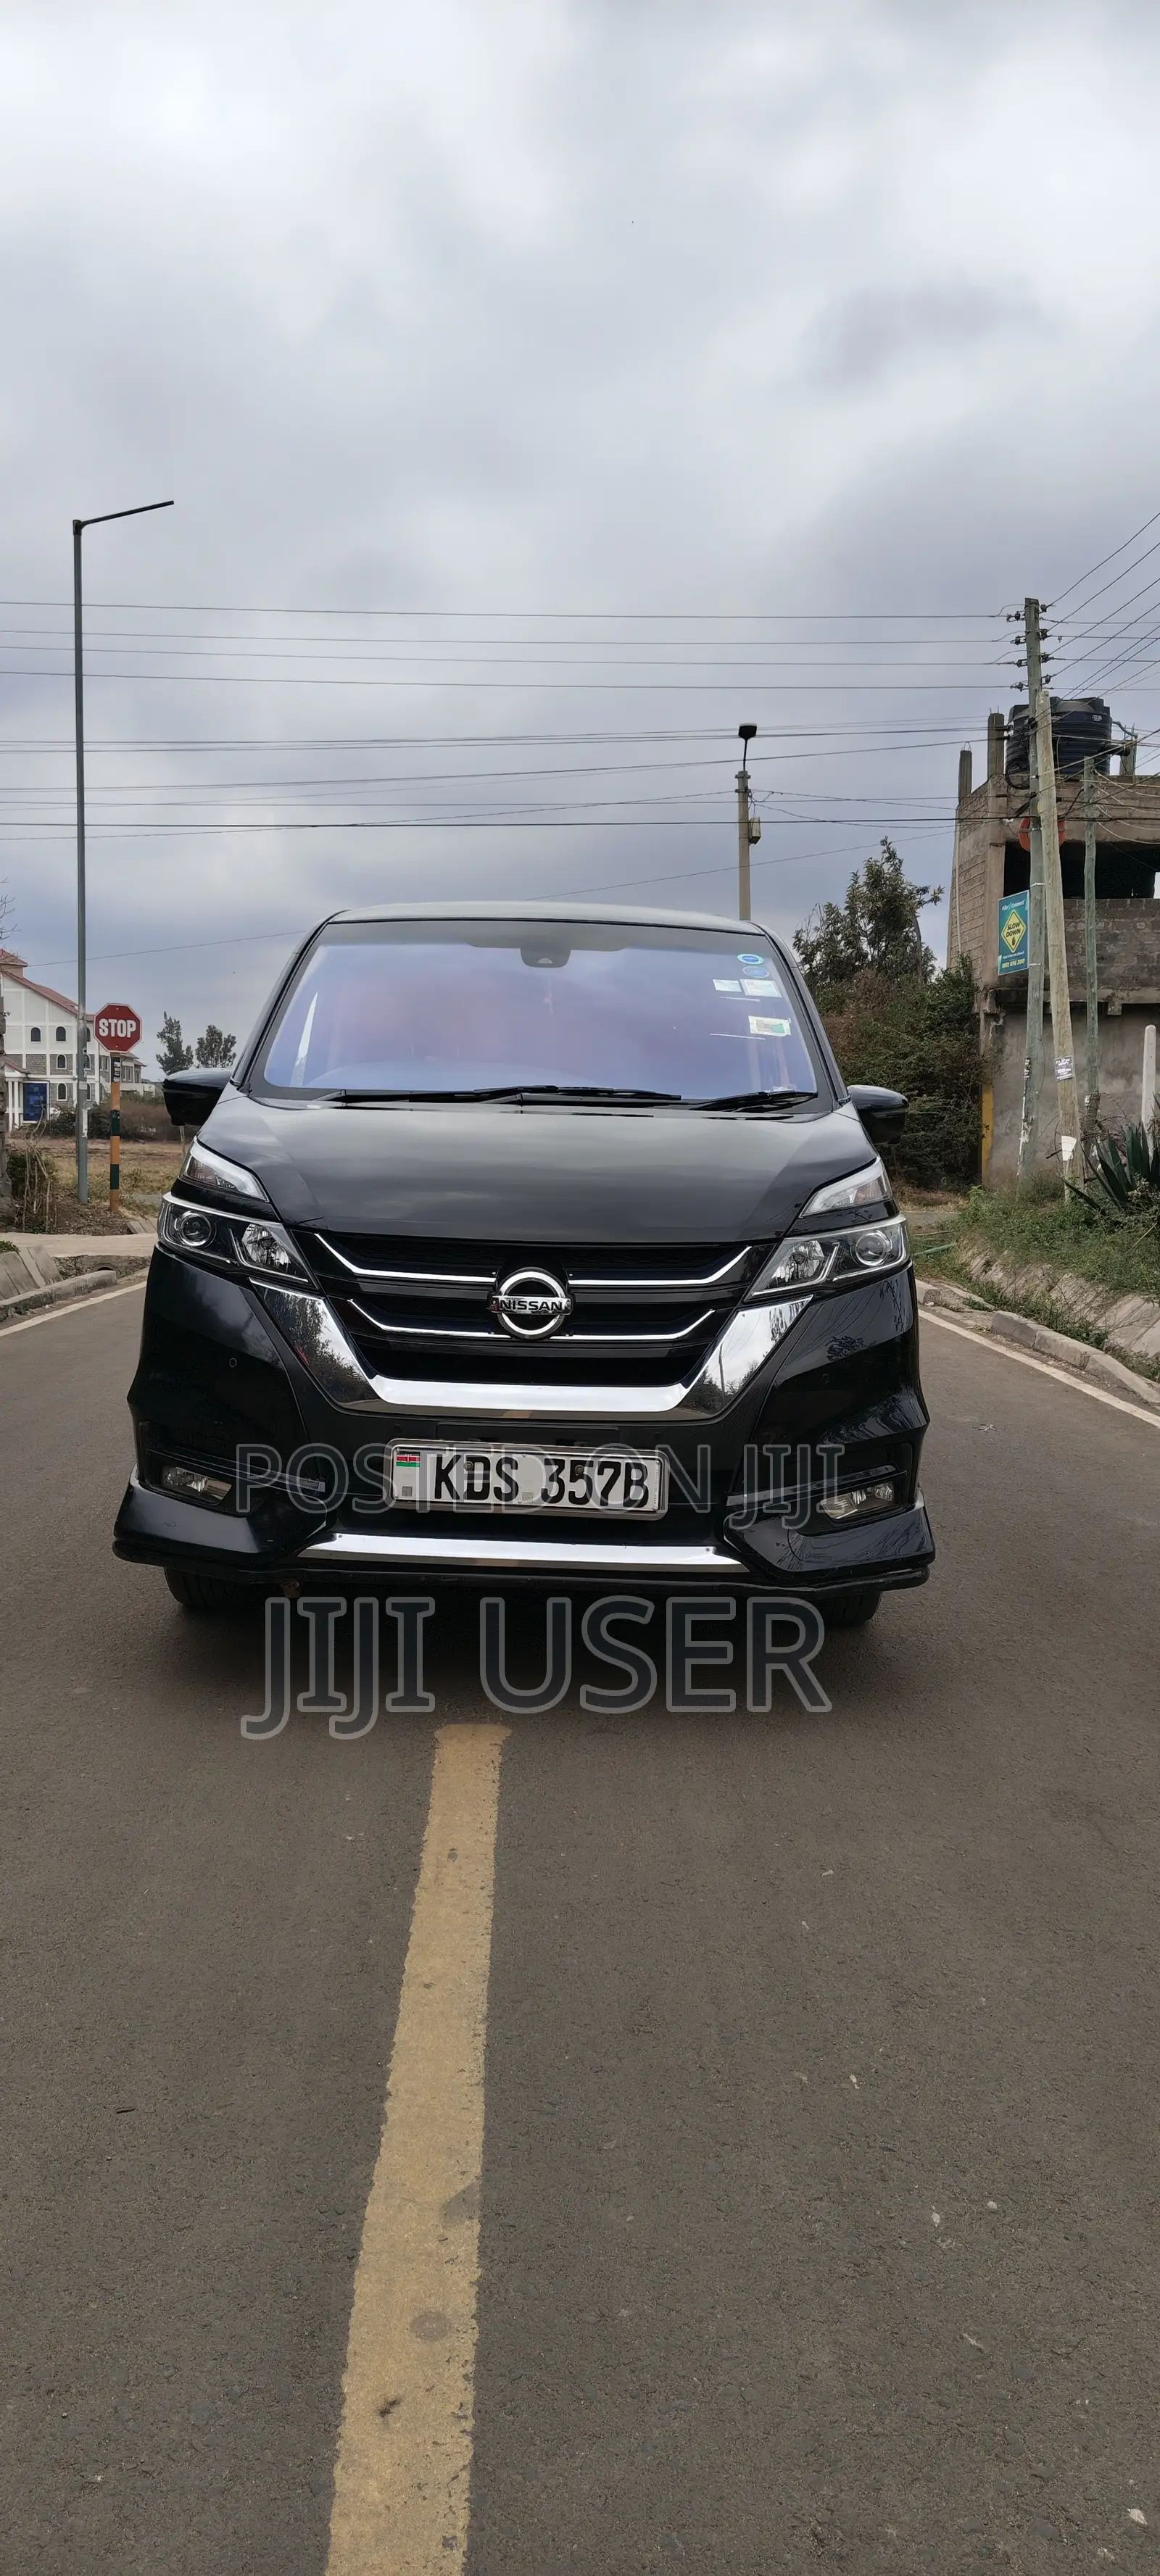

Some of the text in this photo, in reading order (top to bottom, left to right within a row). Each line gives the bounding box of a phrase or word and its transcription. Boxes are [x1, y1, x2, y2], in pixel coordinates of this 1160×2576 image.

[1007, 922, 1020, 931] SLOW
[1006, 928, 1021, 938] DOWN
[99, 1018, 136, 1038] STOP
[500, 1300, 563, 1311] NISSAN
[434, 1453, 519, 1502] KDS
[540, 1458, 650, 1508] 357B
